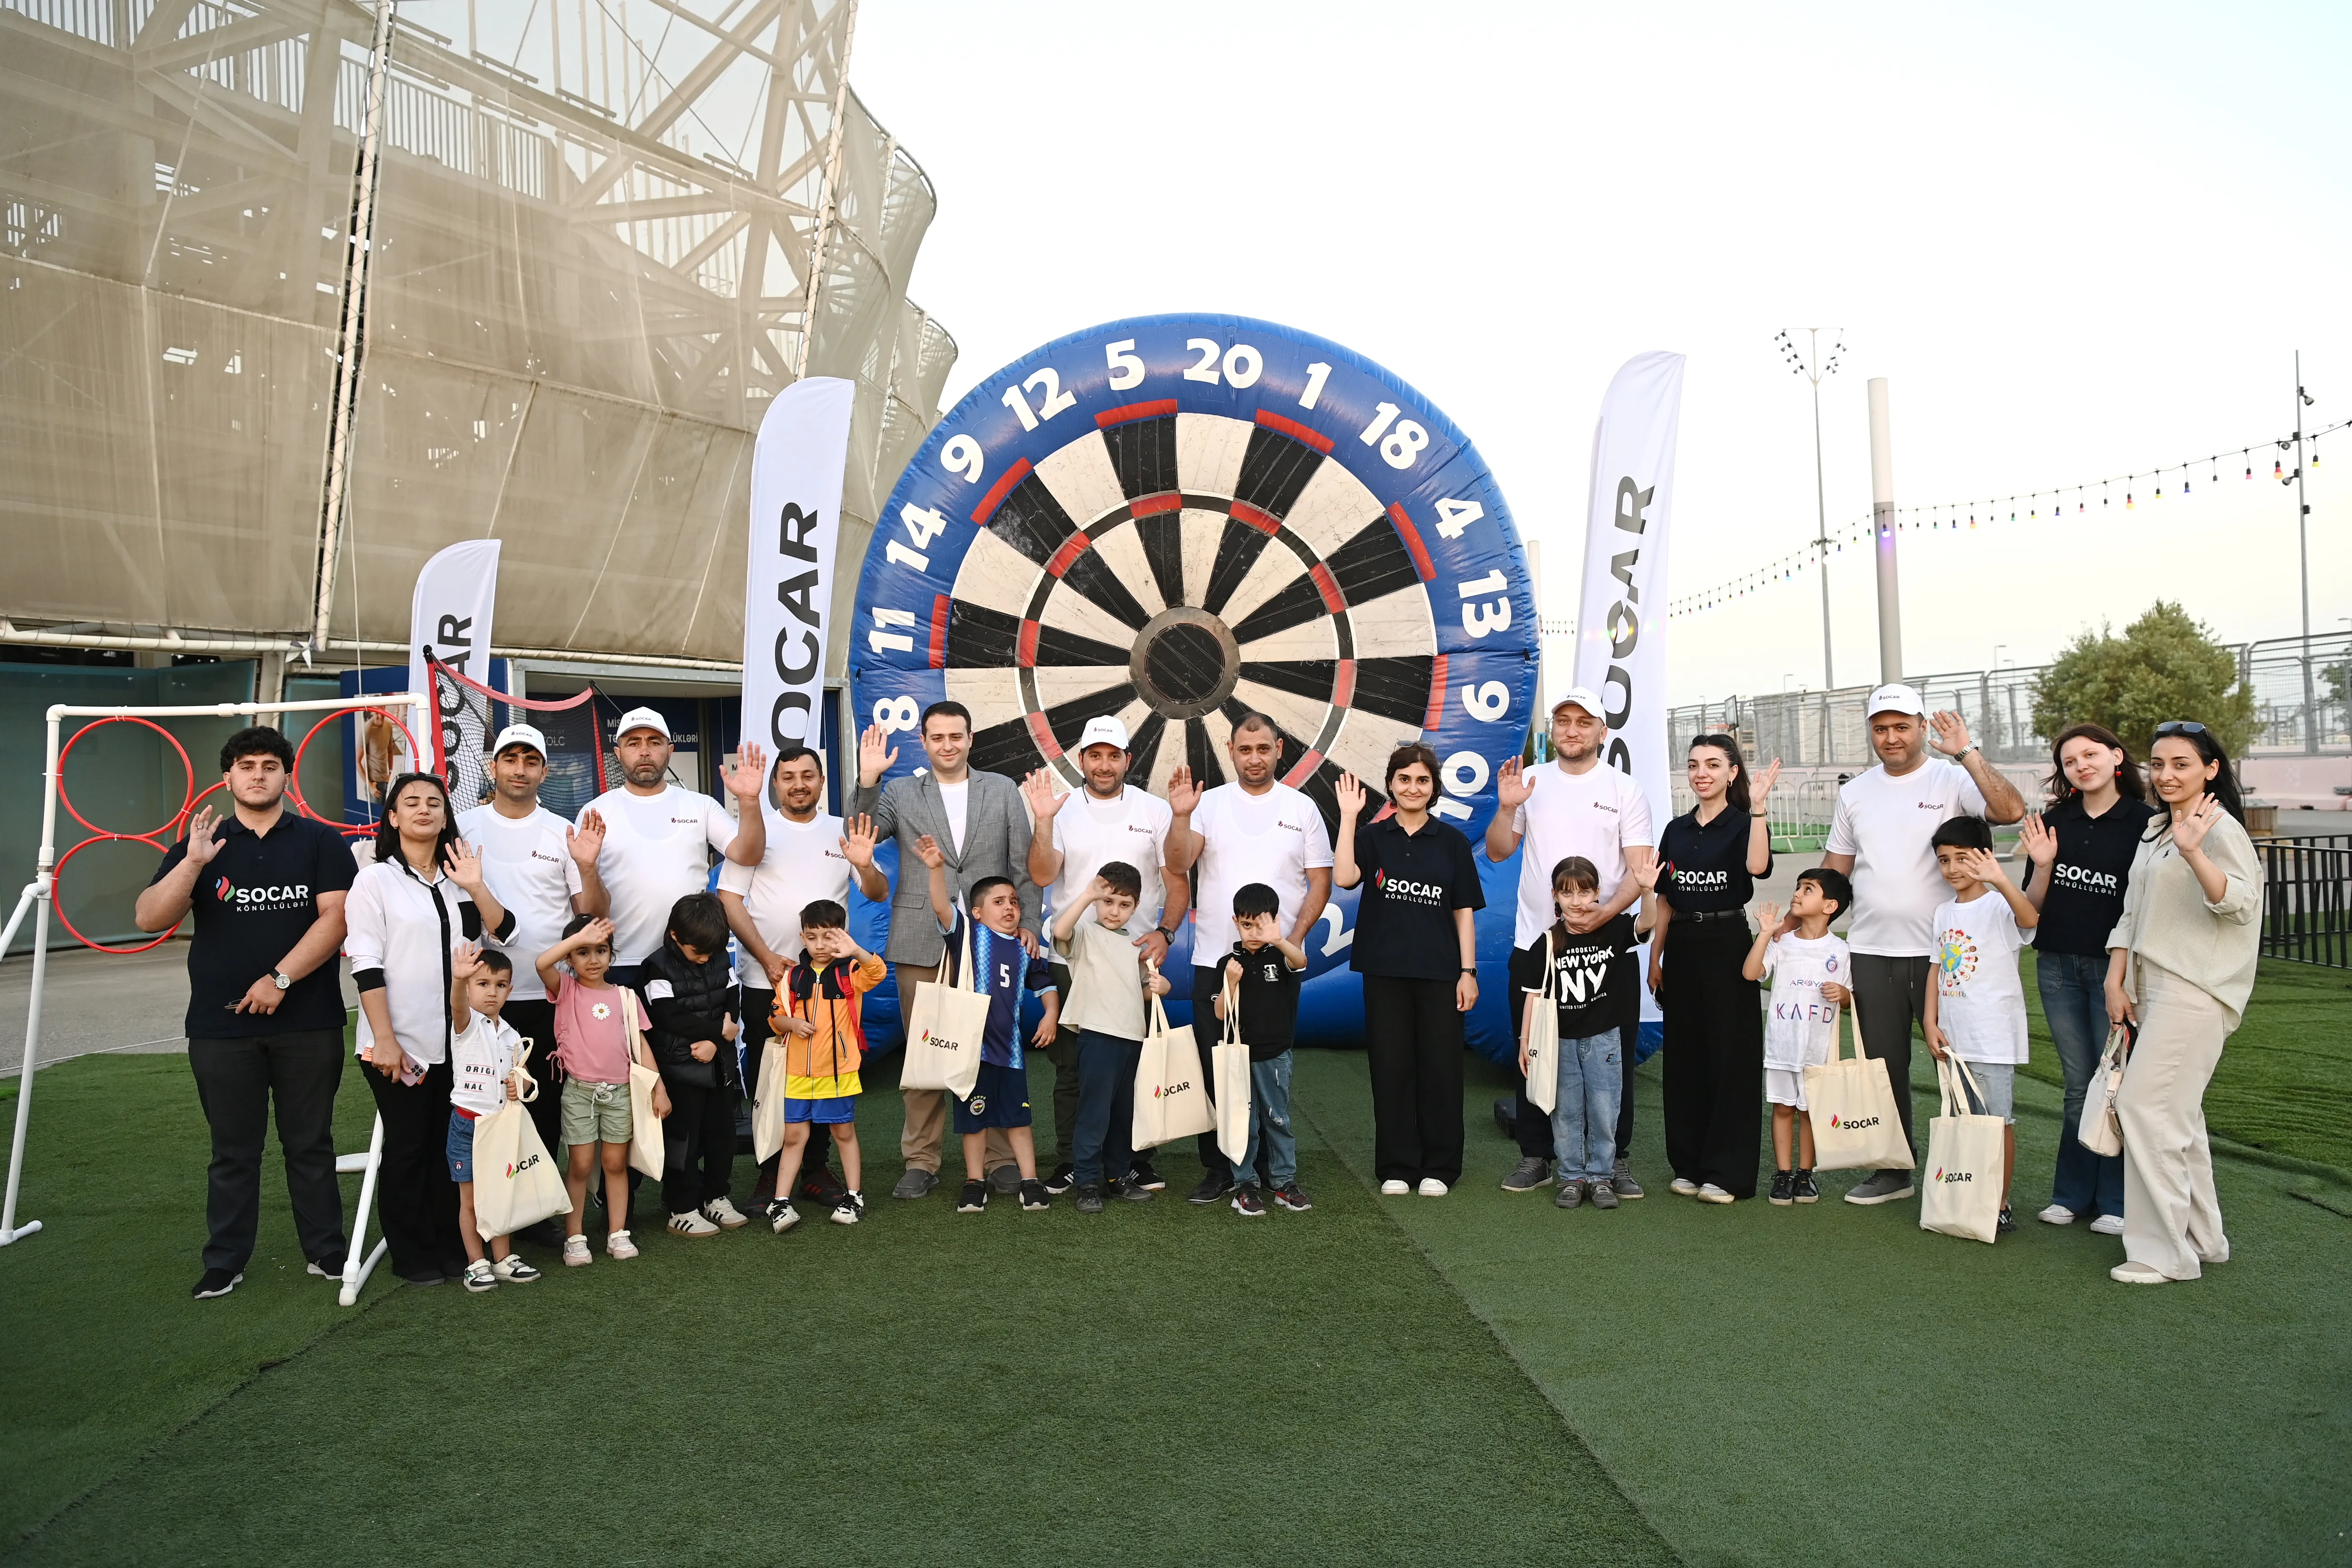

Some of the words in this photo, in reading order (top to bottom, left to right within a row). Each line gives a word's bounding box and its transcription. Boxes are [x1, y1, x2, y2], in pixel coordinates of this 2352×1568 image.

[1105, 338, 1145, 390] 5
[1184, 338, 1263, 389] 20
[1298, 362, 1332, 410] 1
[1001, 367, 1077, 432] 12
[1359, 401, 1429, 470] 18
[940, 434, 984, 484] 9
[1435, 497, 1485, 539] 4
[885, 502, 947, 573] 14
[1457, 569, 1512, 638] 13
[868, 607, 915, 653] 11
[768, 501, 820, 810] OCAR
[872, 695, 920, 735] 8
[1429, 751, 1490, 821] 10
[1599, 805, 1618, 814] SOCAR
[1283, 824, 1302, 833] SOCAR
[538, 854, 560, 863] SOCAR
[1386, 879, 1443, 899] SOCAR
[1677, 871, 1728, 885] SOCAR
[2055, 863, 2117, 889] SOCAR
[236, 885, 309, 904] SOCAR
[1318, 902, 1355, 958] 2
[1555, 955, 1580, 970] NEW
[1582, 945, 1614, 967] YORK
[999, 963, 1010, 988] 5
[1560, 963, 1607, 1003] NY
[1777, 1003, 1833, 1024] KAFD
[929, 1037, 958, 1051] SOCAR
[466, 1065, 495, 1076] ORIGI
[464, 1083, 483, 1091] NAL
[1163, 1081, 1190, 1099] OCAR
[1843, 1116, 1880, 1130] SOCAR
[1944, 1172, 1972, 1183] SOCAR
